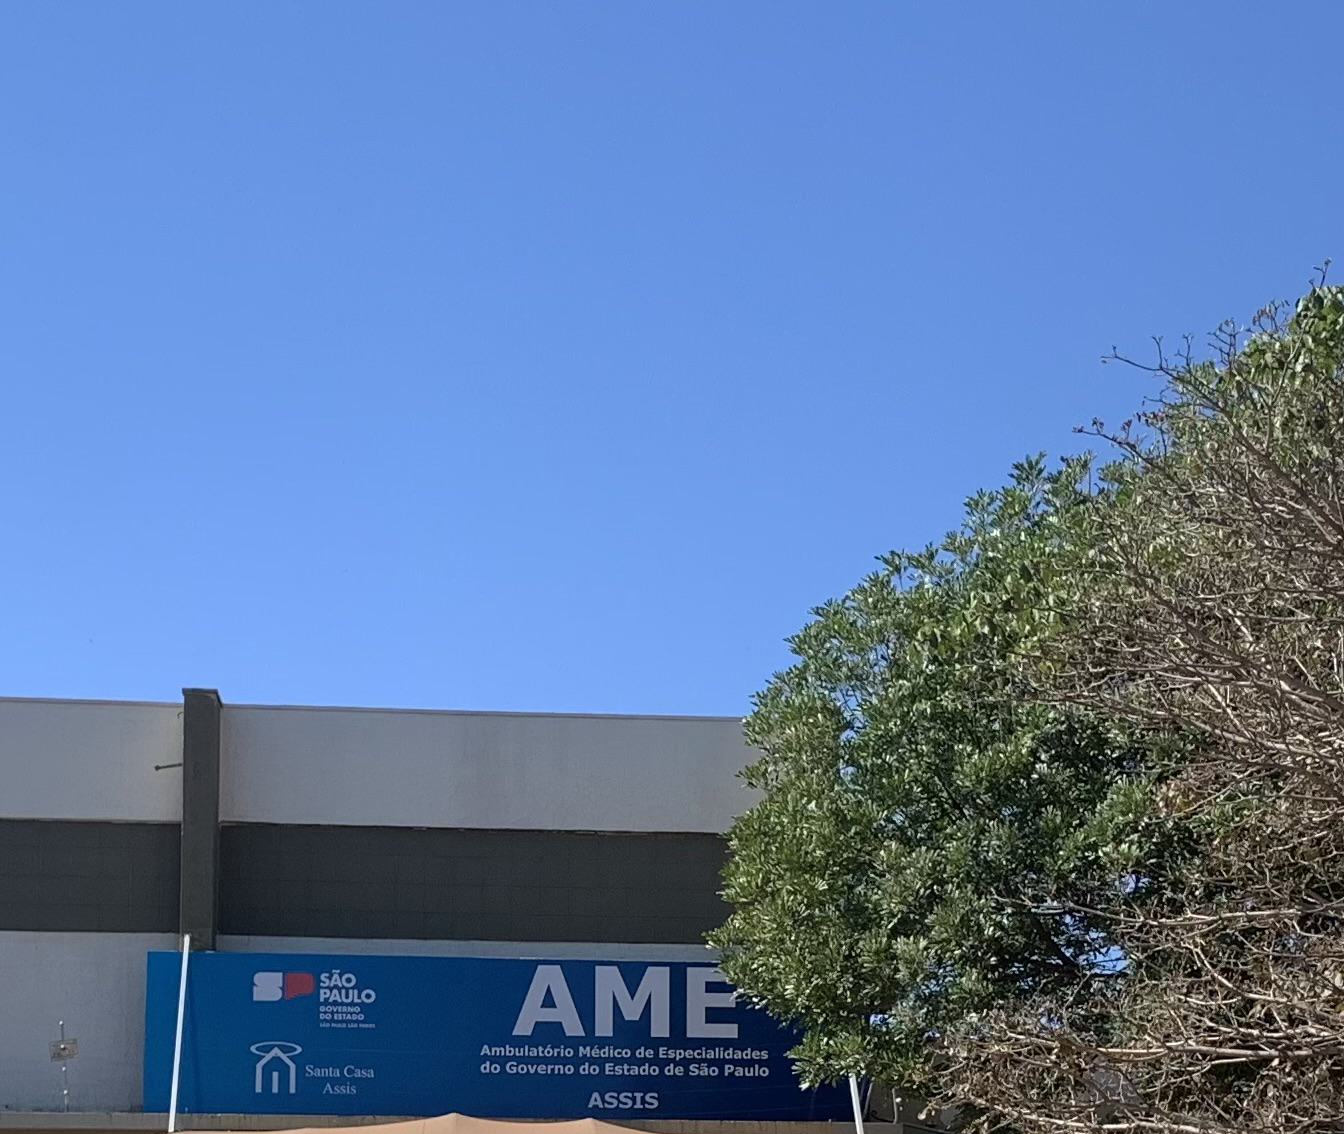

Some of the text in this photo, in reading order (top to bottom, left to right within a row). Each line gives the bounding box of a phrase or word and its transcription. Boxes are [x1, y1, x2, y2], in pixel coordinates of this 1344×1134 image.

[320, 970, 356, 987] SÃO
[320, 989, 376, 1003] PAULO
[511, 965, 738, 1038] AME
[480, 1044, 769, 1061] Ambulatório Médico de Especialidades
[306, 1065, 374, 1078] Santa Casa
[480, 1061, 769, 1077] do Governo do Estado de São Paulo
[322, 1082, 356, 1094] Assis
[588, 1091, 659, 1109] ASSIS
